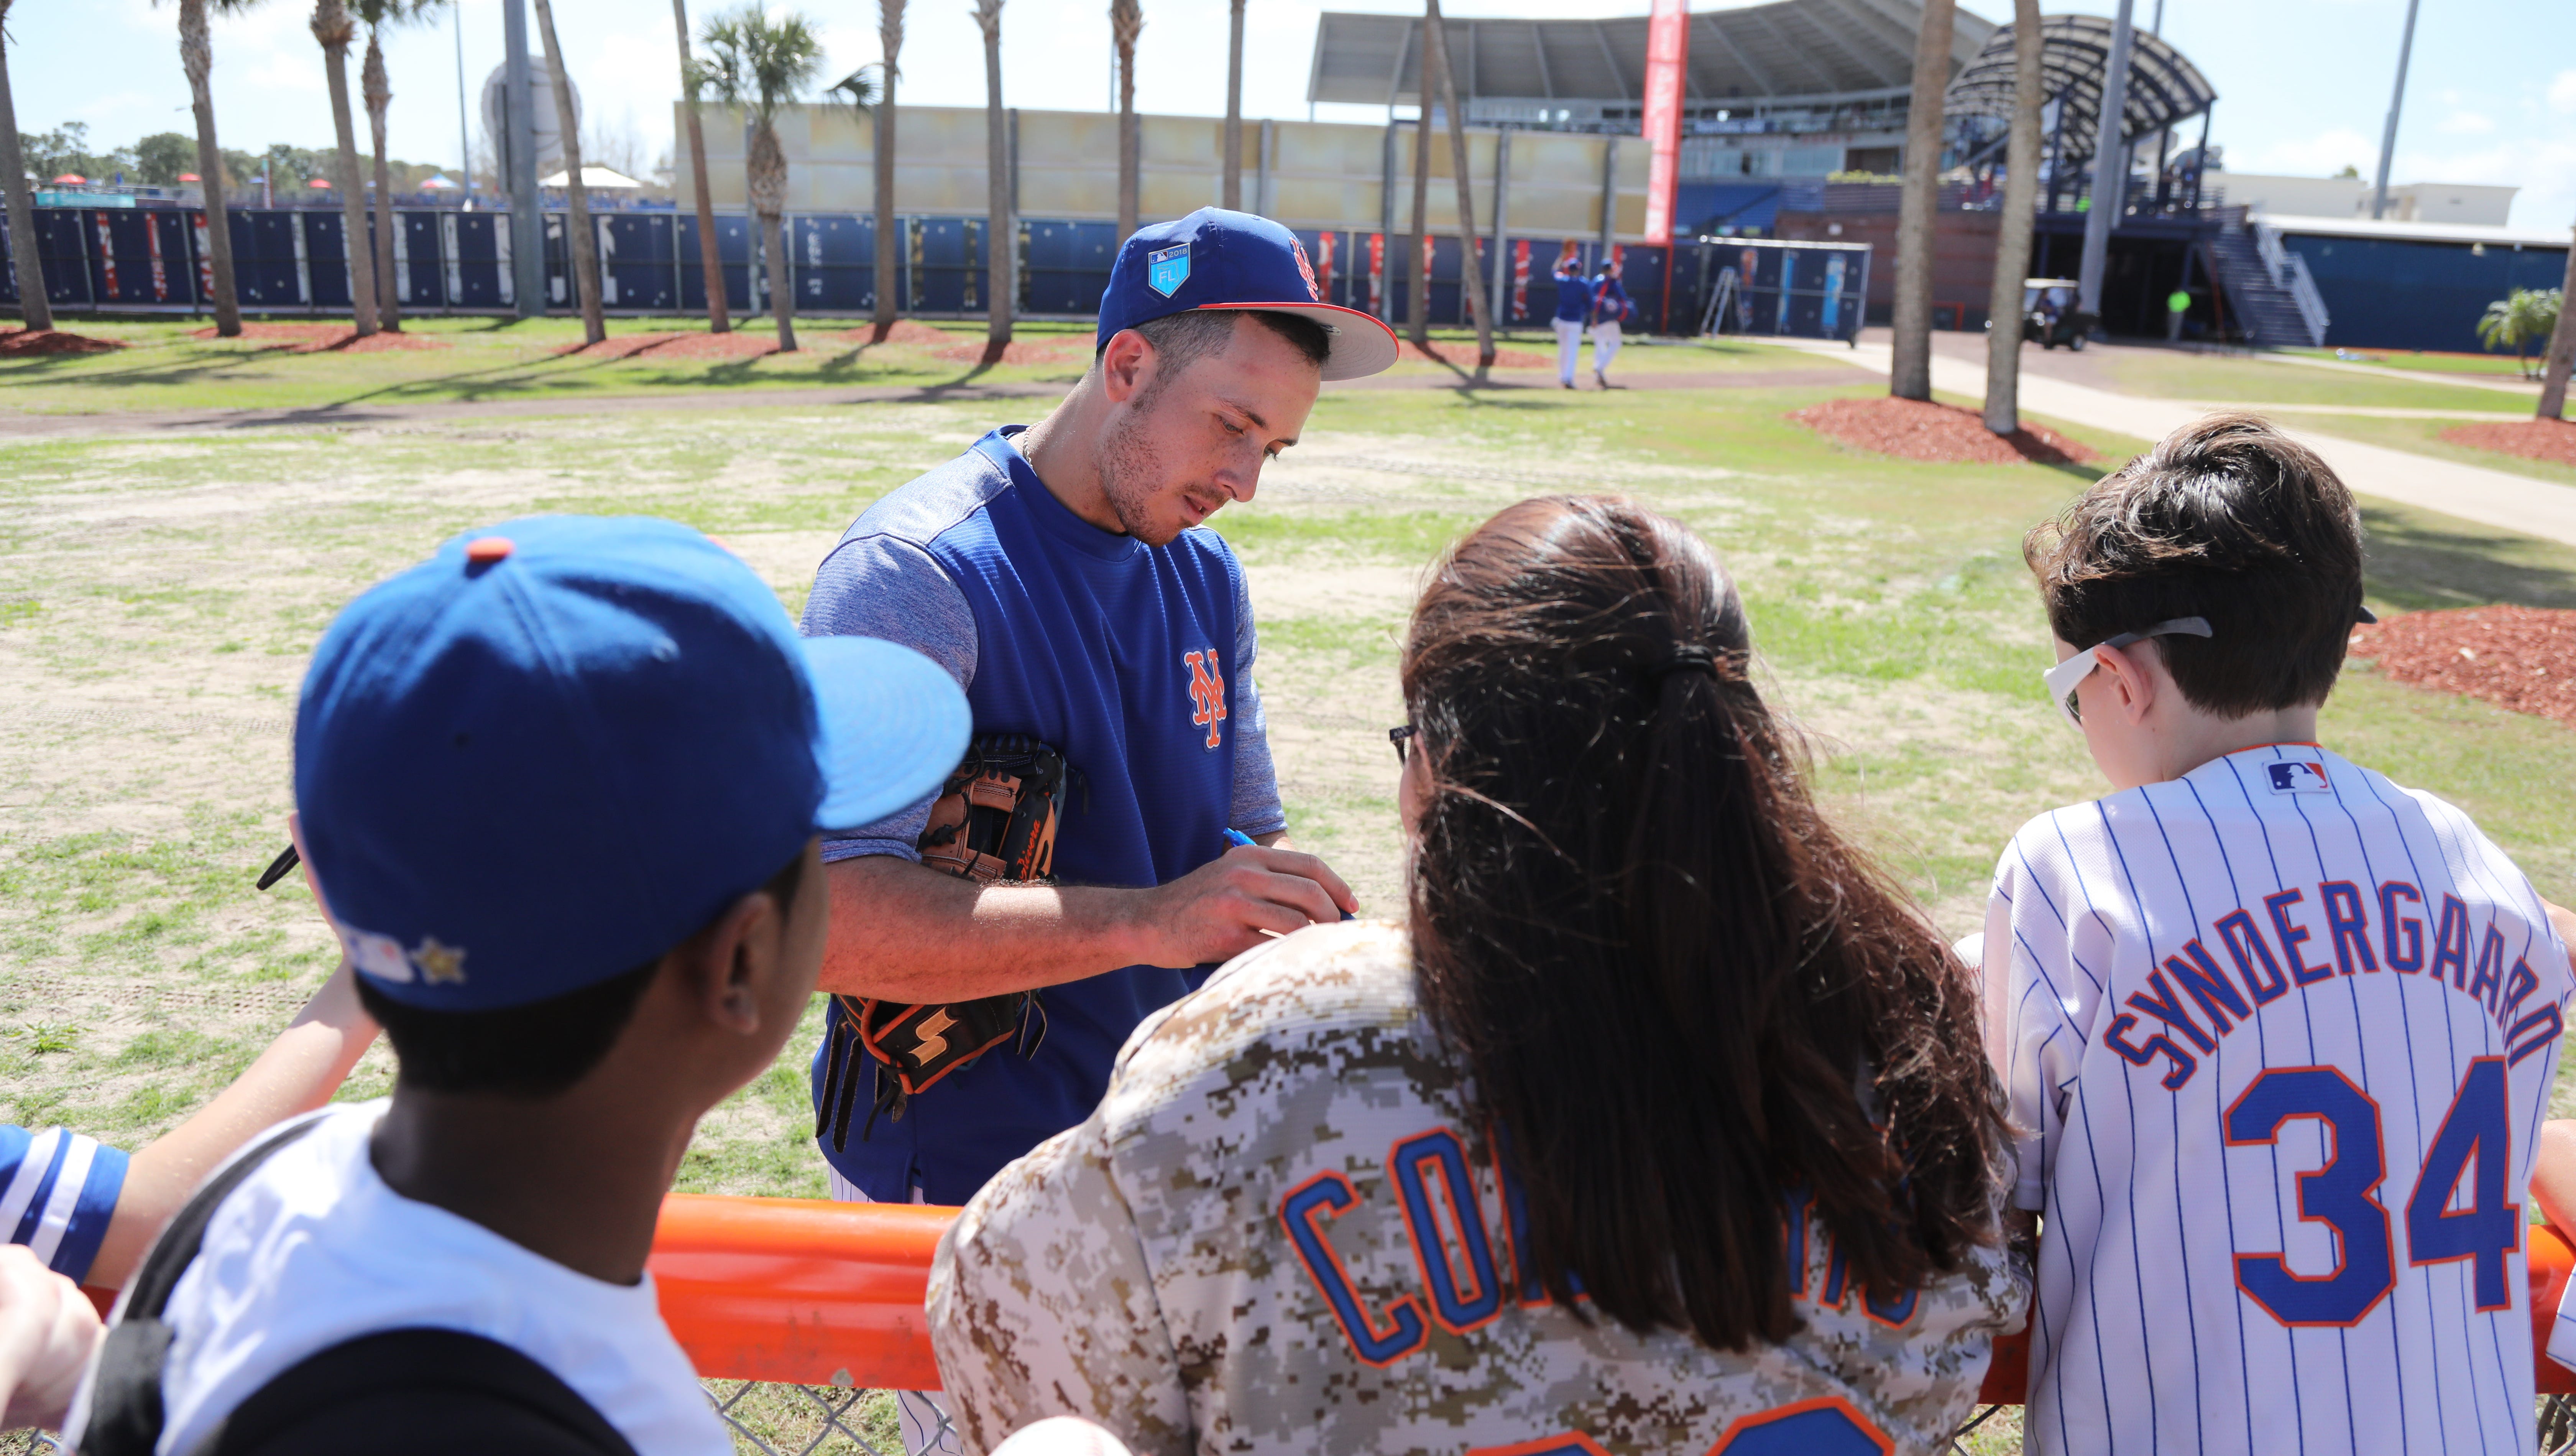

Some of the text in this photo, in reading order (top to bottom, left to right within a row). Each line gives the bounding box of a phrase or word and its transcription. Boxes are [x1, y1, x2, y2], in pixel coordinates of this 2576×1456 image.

[1159, 270, 1176, 284] FL
[1169, 248, 1188, 258] 2018
[1184, 648, 1227, 749] NY
[2103, 880, 2564, 1092] SYNDERGAARD
[2223, 1055, 2520, 1327] 34
